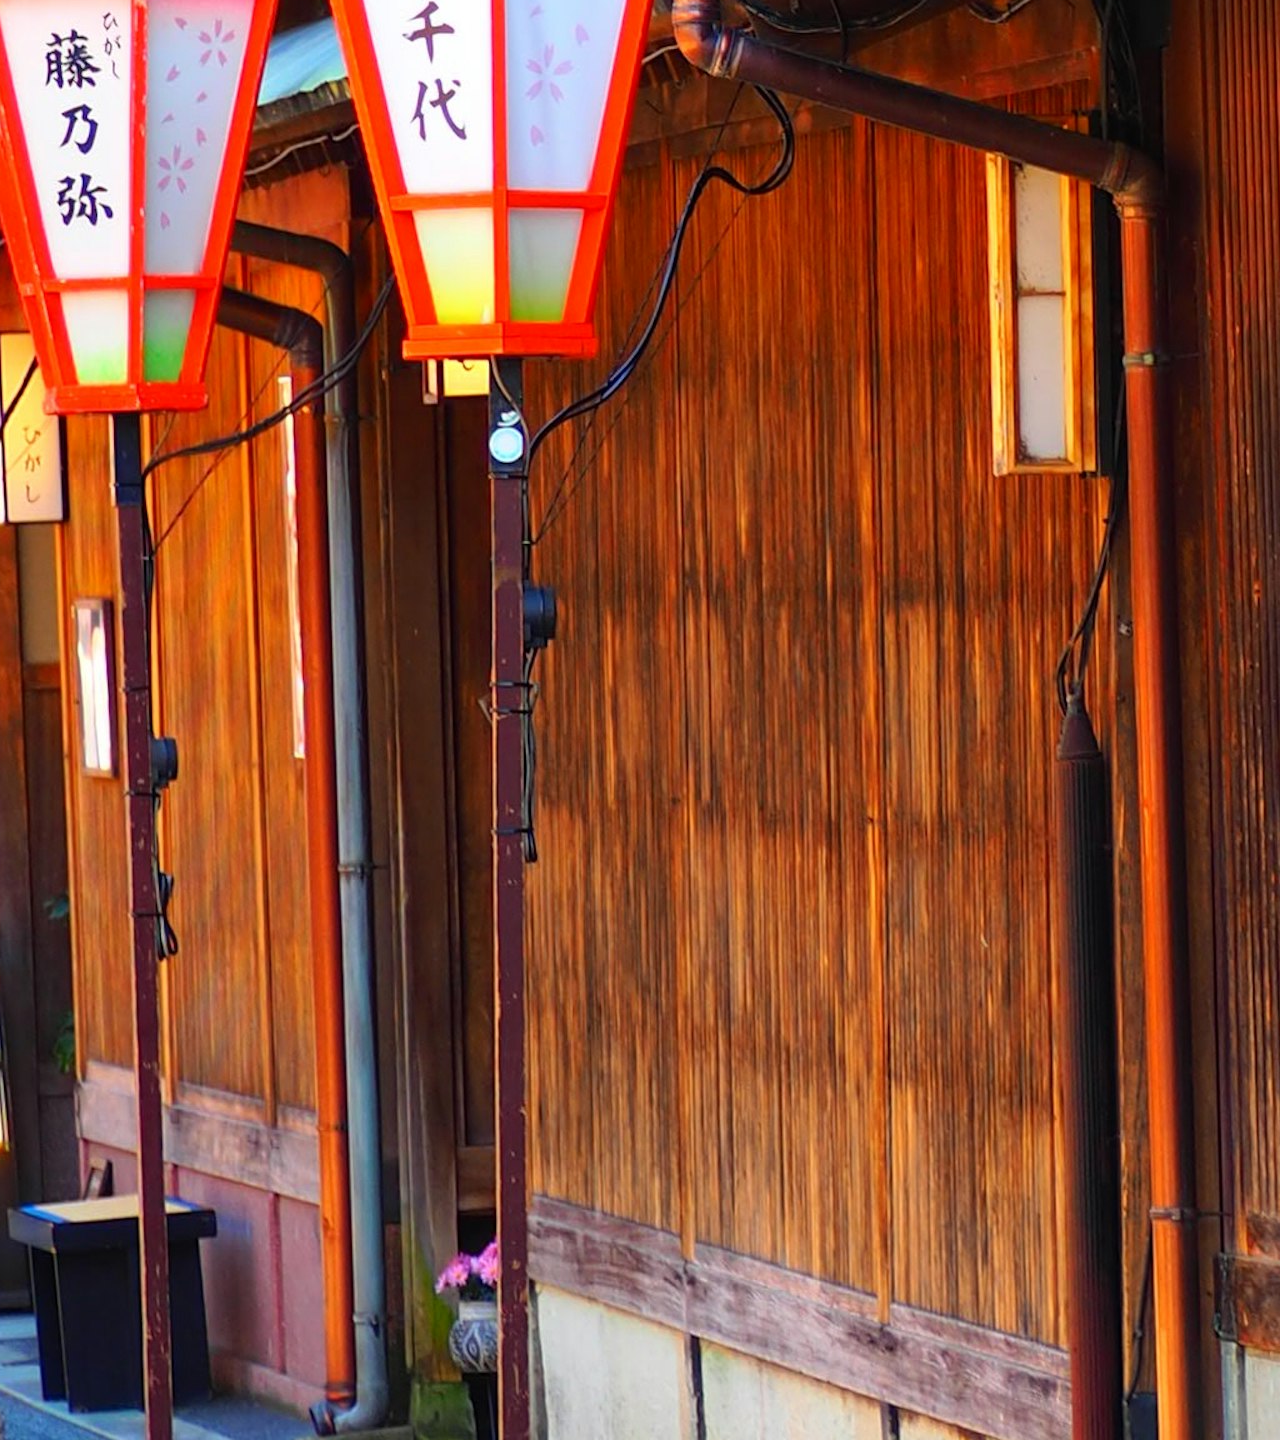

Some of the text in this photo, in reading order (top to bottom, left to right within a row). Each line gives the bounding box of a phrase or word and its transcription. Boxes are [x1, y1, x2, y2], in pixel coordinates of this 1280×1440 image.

[102, 11, 122, 80] ひがし
[44, 29, 113, 227] 藤乃弥
[22, 424, 43, 504] ひがし
